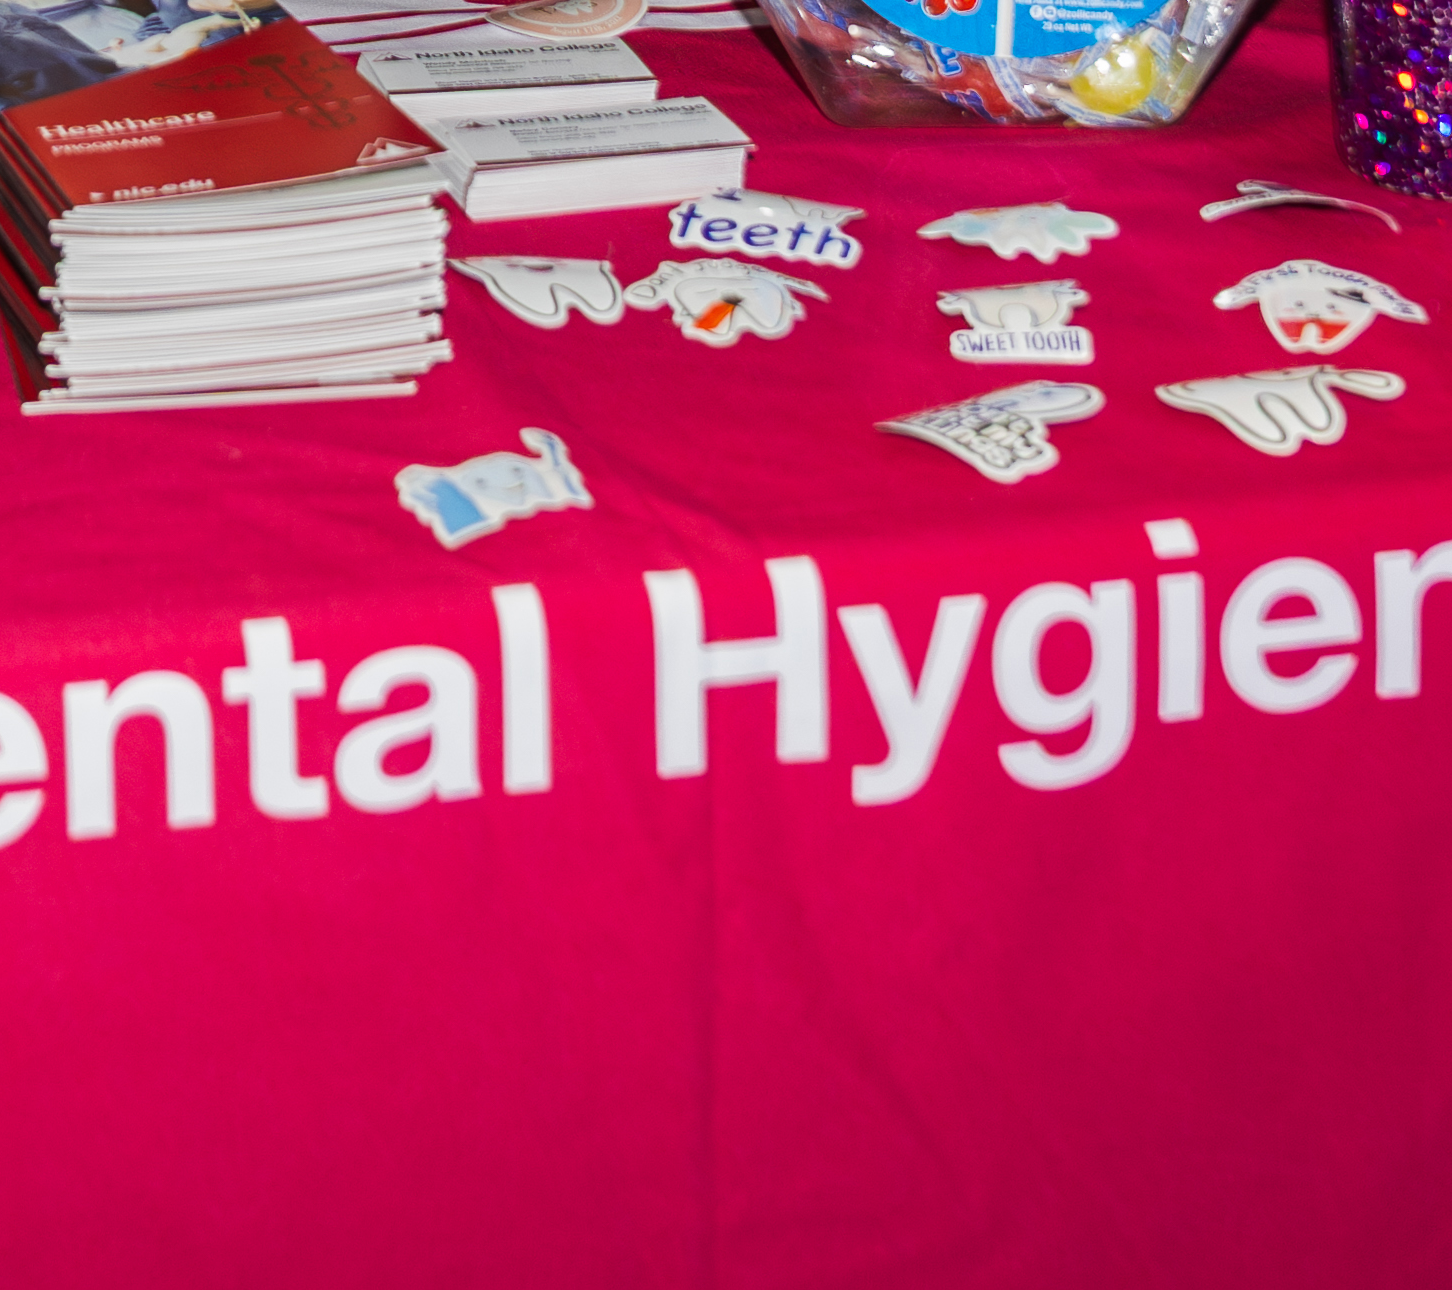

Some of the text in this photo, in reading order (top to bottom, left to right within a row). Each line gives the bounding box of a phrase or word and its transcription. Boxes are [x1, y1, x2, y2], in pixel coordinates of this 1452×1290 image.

[415, 41, 617, 61] North Idaho College
[38, 110, 216, 141] Healthcare
[499, 102, 707, 127] North Idaho College
[51, 135, 165, 157] PROGRAMS
[112, 178, 215, 202] nic.edu
[677, 203, 851, 259] teeth
[957, 331, 1081, 352] SWEET TOOTH
